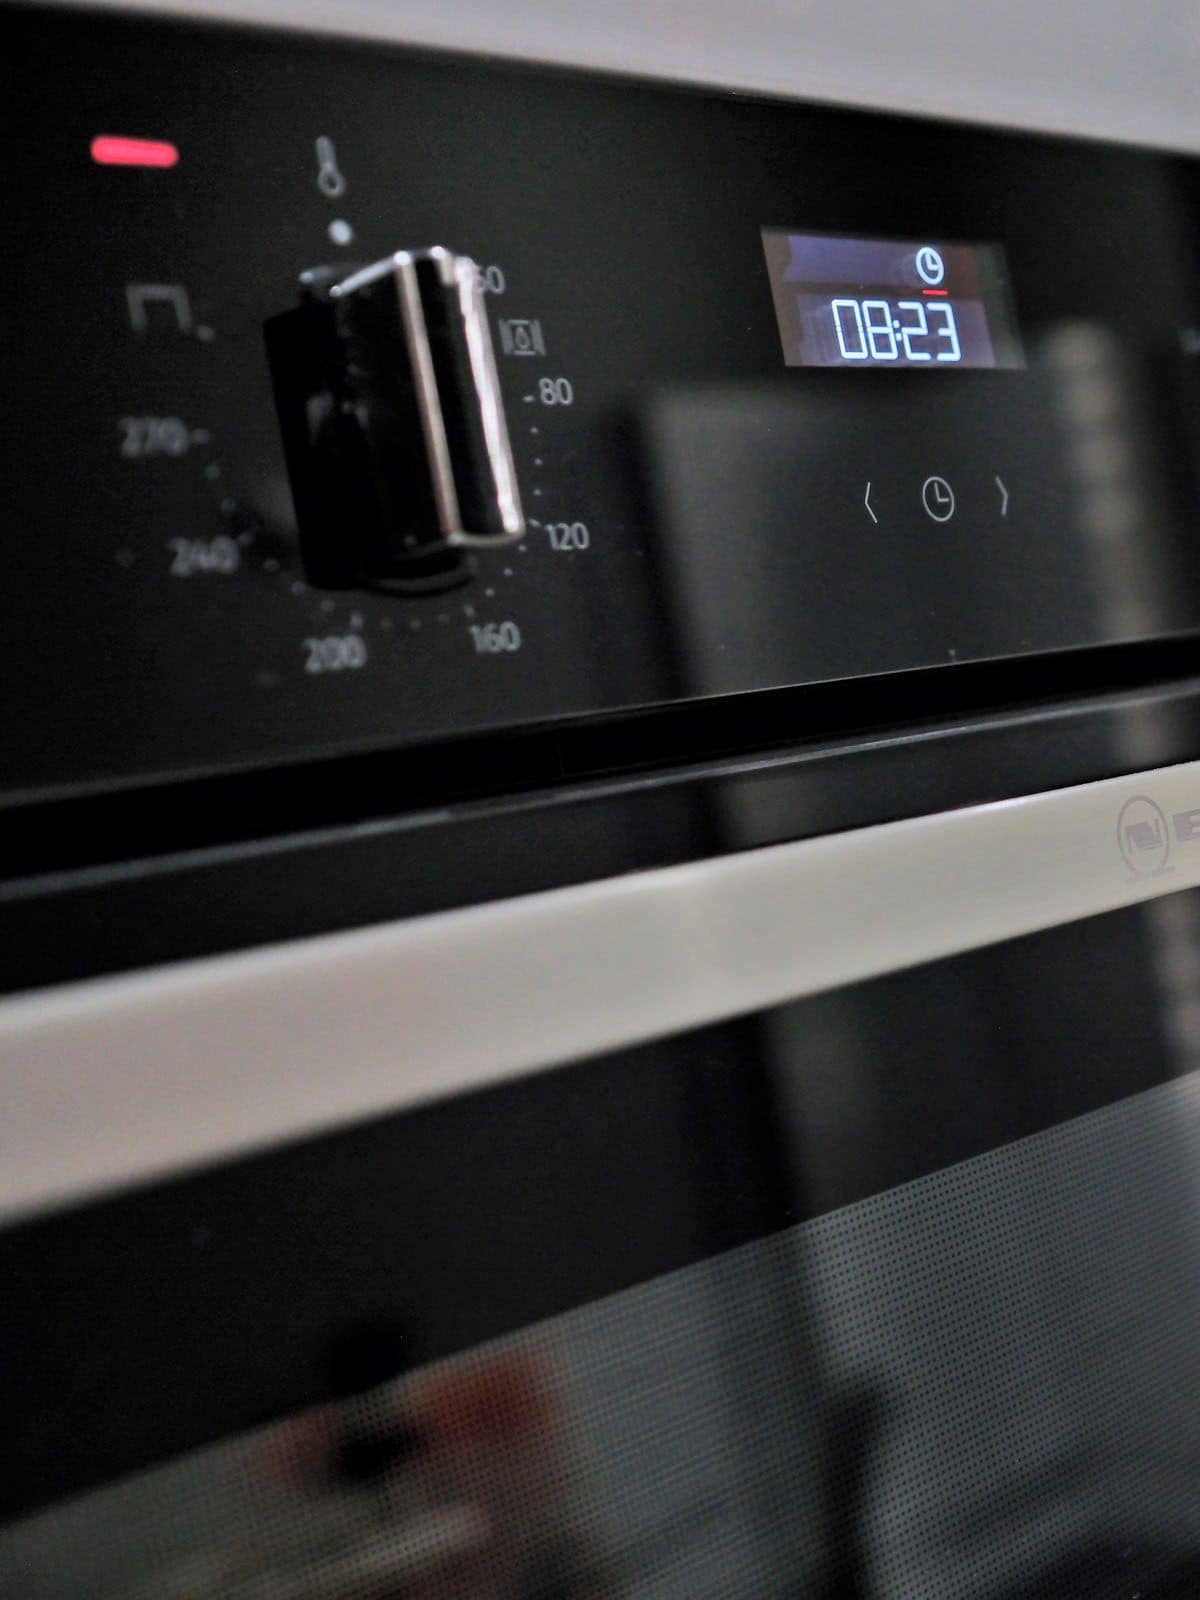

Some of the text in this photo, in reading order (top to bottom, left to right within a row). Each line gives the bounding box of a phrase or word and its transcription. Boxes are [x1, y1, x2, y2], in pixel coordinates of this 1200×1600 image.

[831, 299, 961, 362] 08:23
[538, 377, 574, 406] 80
[545, 522, 590, 550] 120
[167, 535, 240, 576] 240
[304, 634, 367, 675] 200
[469, 621, 522, 654] 160
